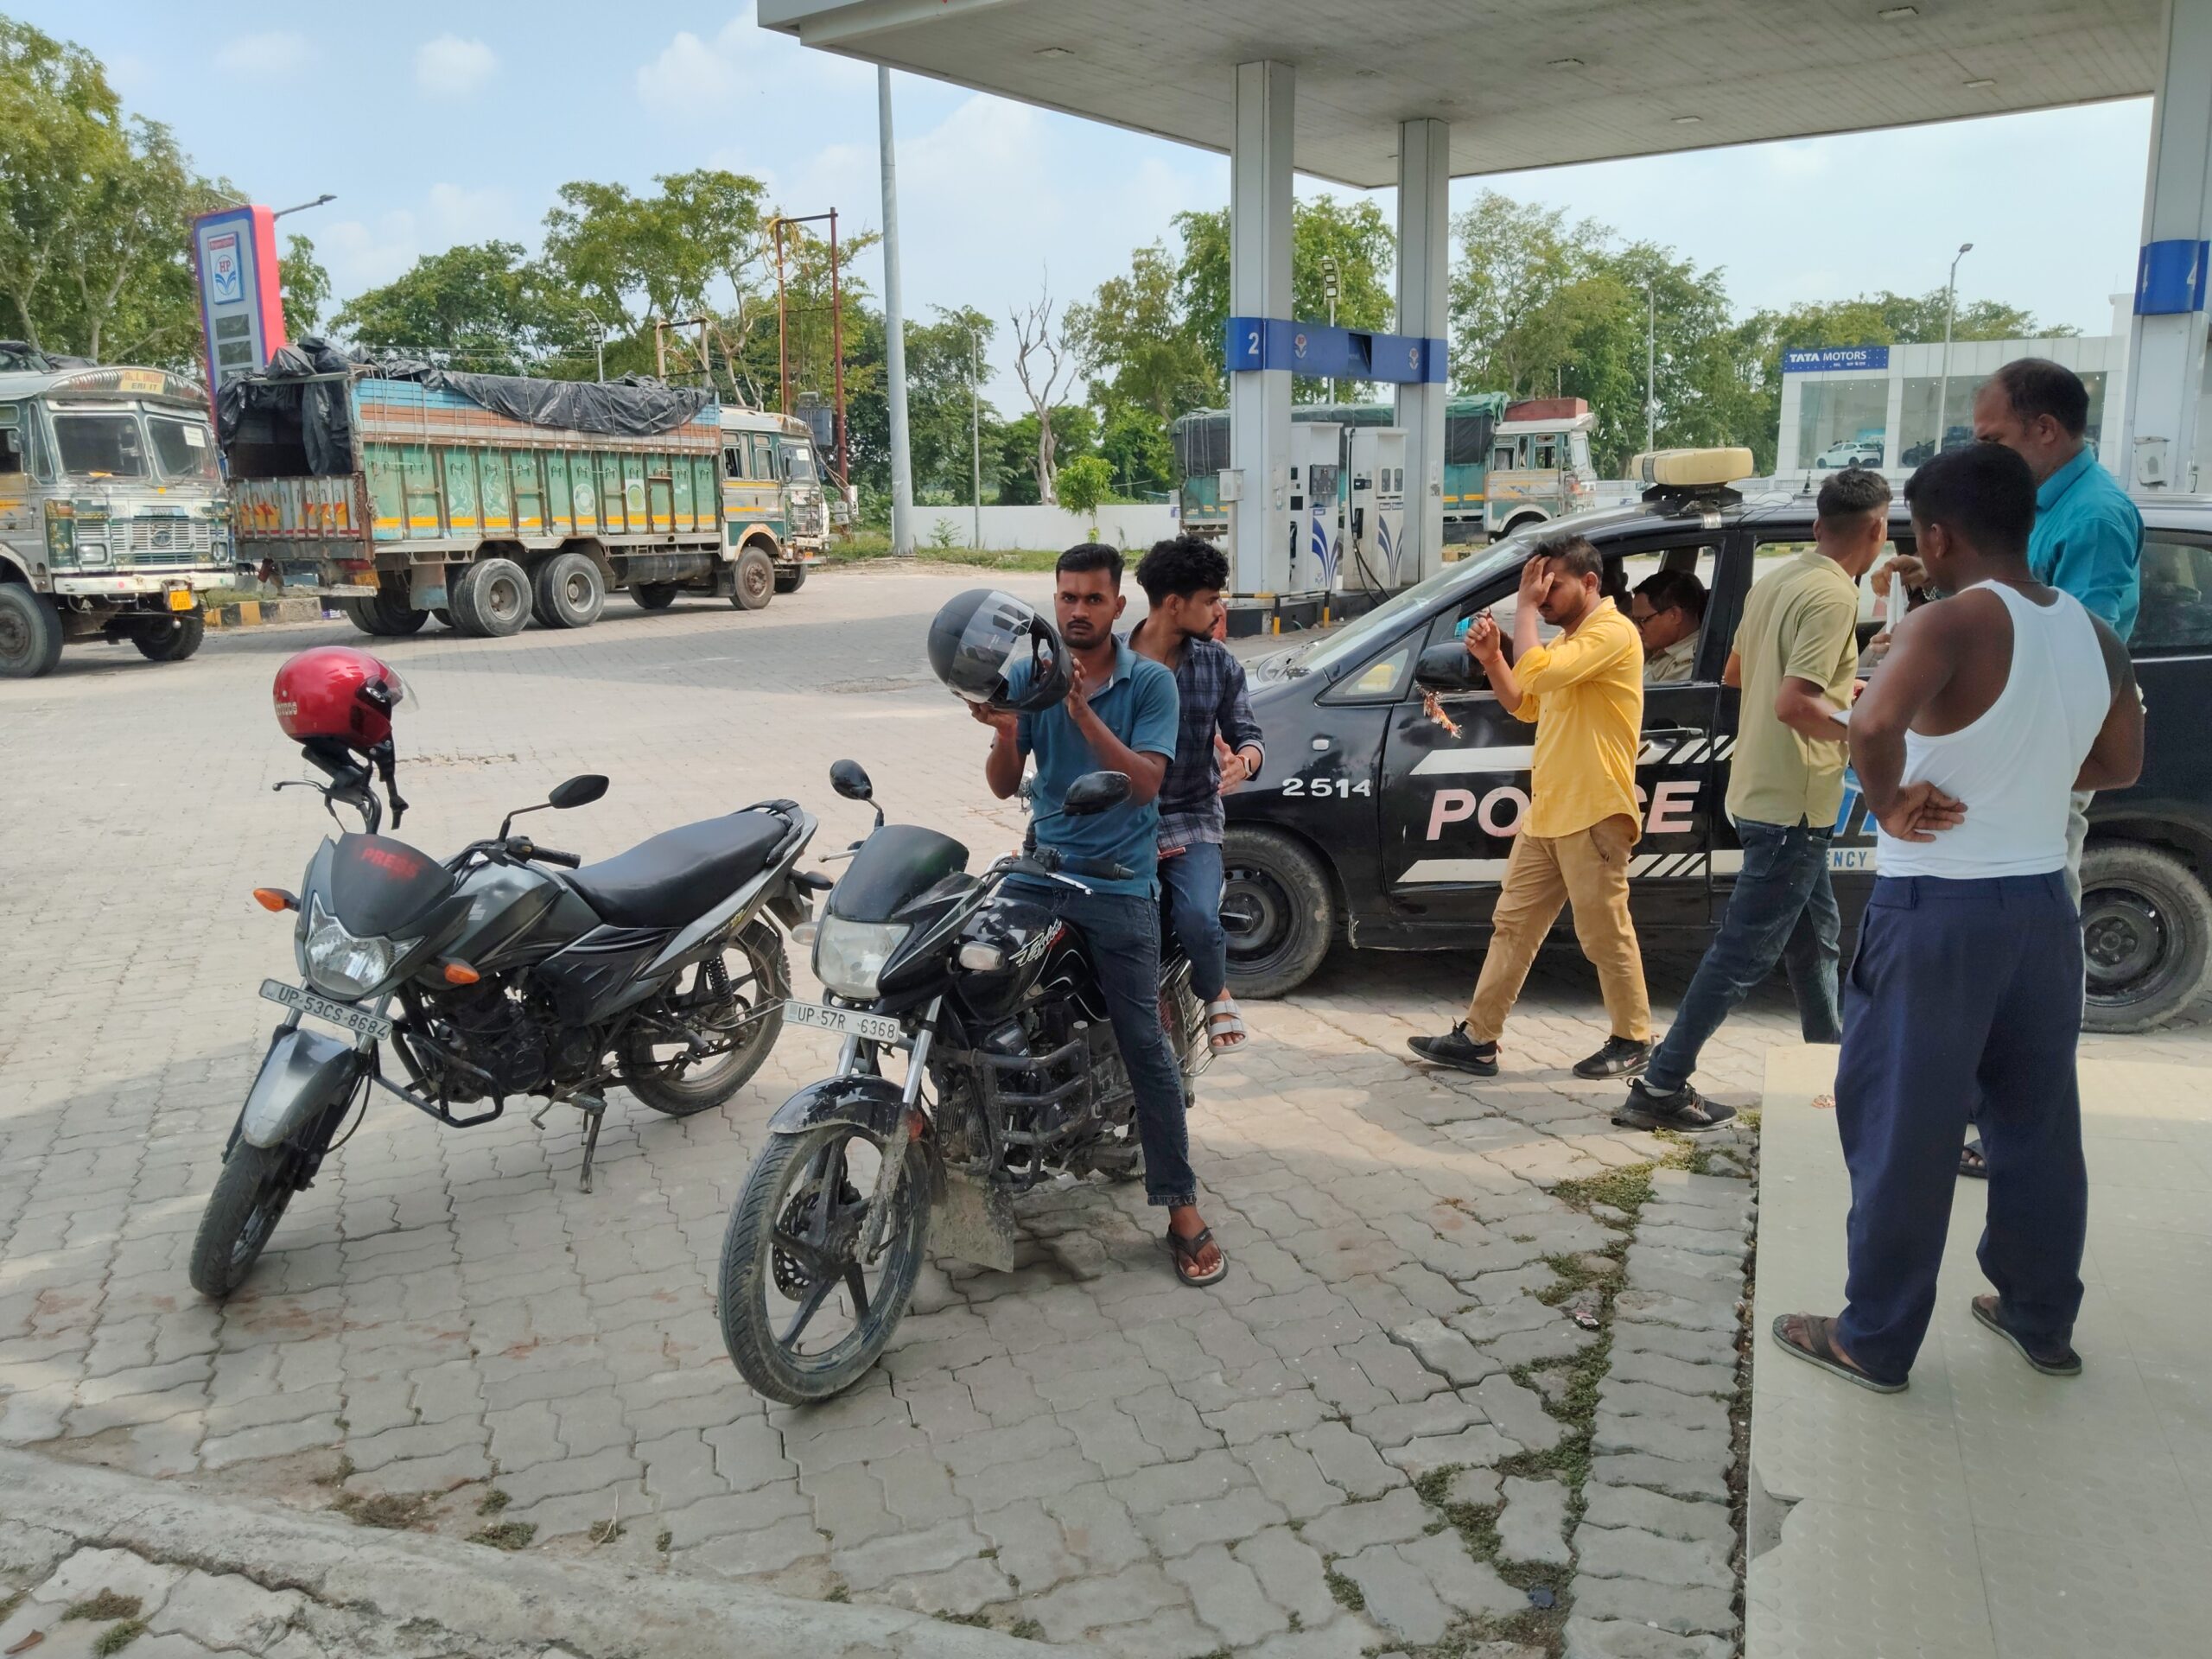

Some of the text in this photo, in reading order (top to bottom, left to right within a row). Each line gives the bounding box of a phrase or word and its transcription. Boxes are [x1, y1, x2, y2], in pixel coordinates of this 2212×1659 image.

[219, 260, 231, 272] HP
[1248, 332, 1260, 355] 2
[1789, 351, 1867, 363] TATA MOTORS
[1282, 778, 1371, 798] 2514
[1427, 780, 1700, 841] POE
[798, 1006, 896, 1039] UP 57R 6368
